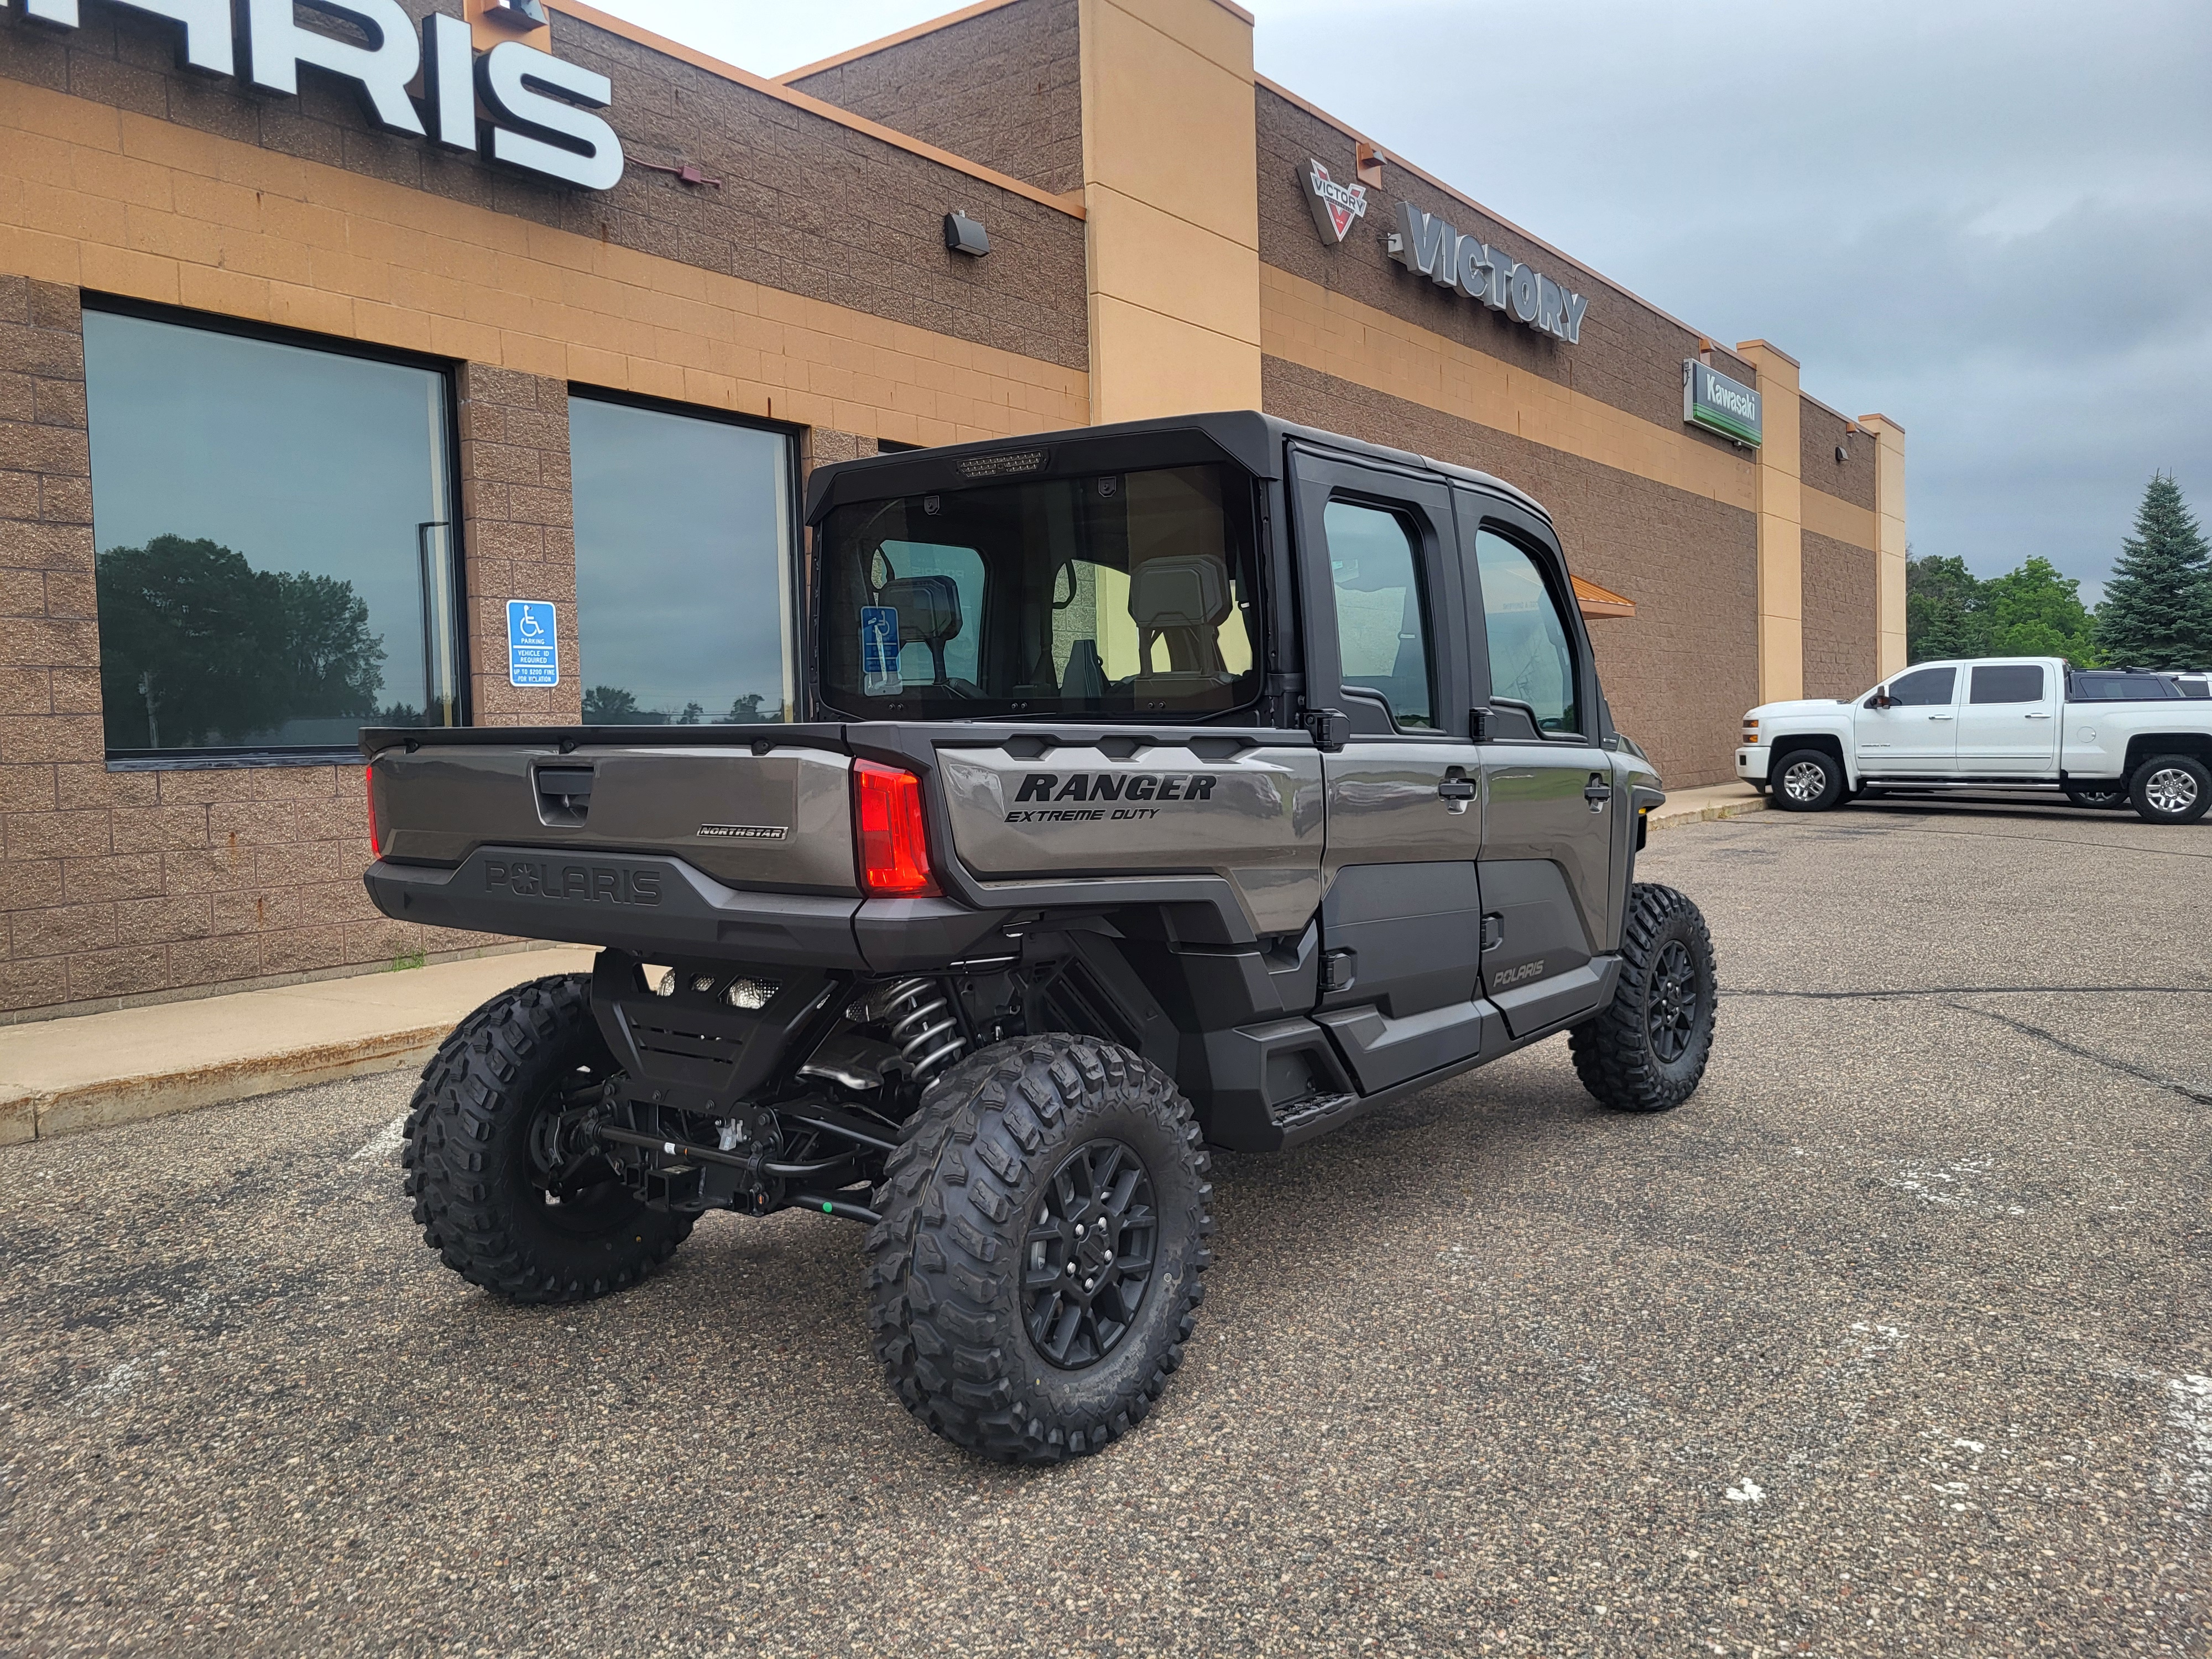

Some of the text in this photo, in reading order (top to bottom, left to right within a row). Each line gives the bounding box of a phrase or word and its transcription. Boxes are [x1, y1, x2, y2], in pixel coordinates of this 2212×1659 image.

[1314, 178, 1363, 212] VICTORY
[1405, 201, 1588, 344] VICTORY
[1707, 374, 1755, 421] Kawasaki
[1014, 774, 1217, 802] RANGER
[1003, 808, 1161, 823] EXTREME DUTY
[700, 827, 782, 837] NORTHSTAR
[484, 860, 664, 907] POLARIS
[1493, 959, 1545, 987] POLARIS
